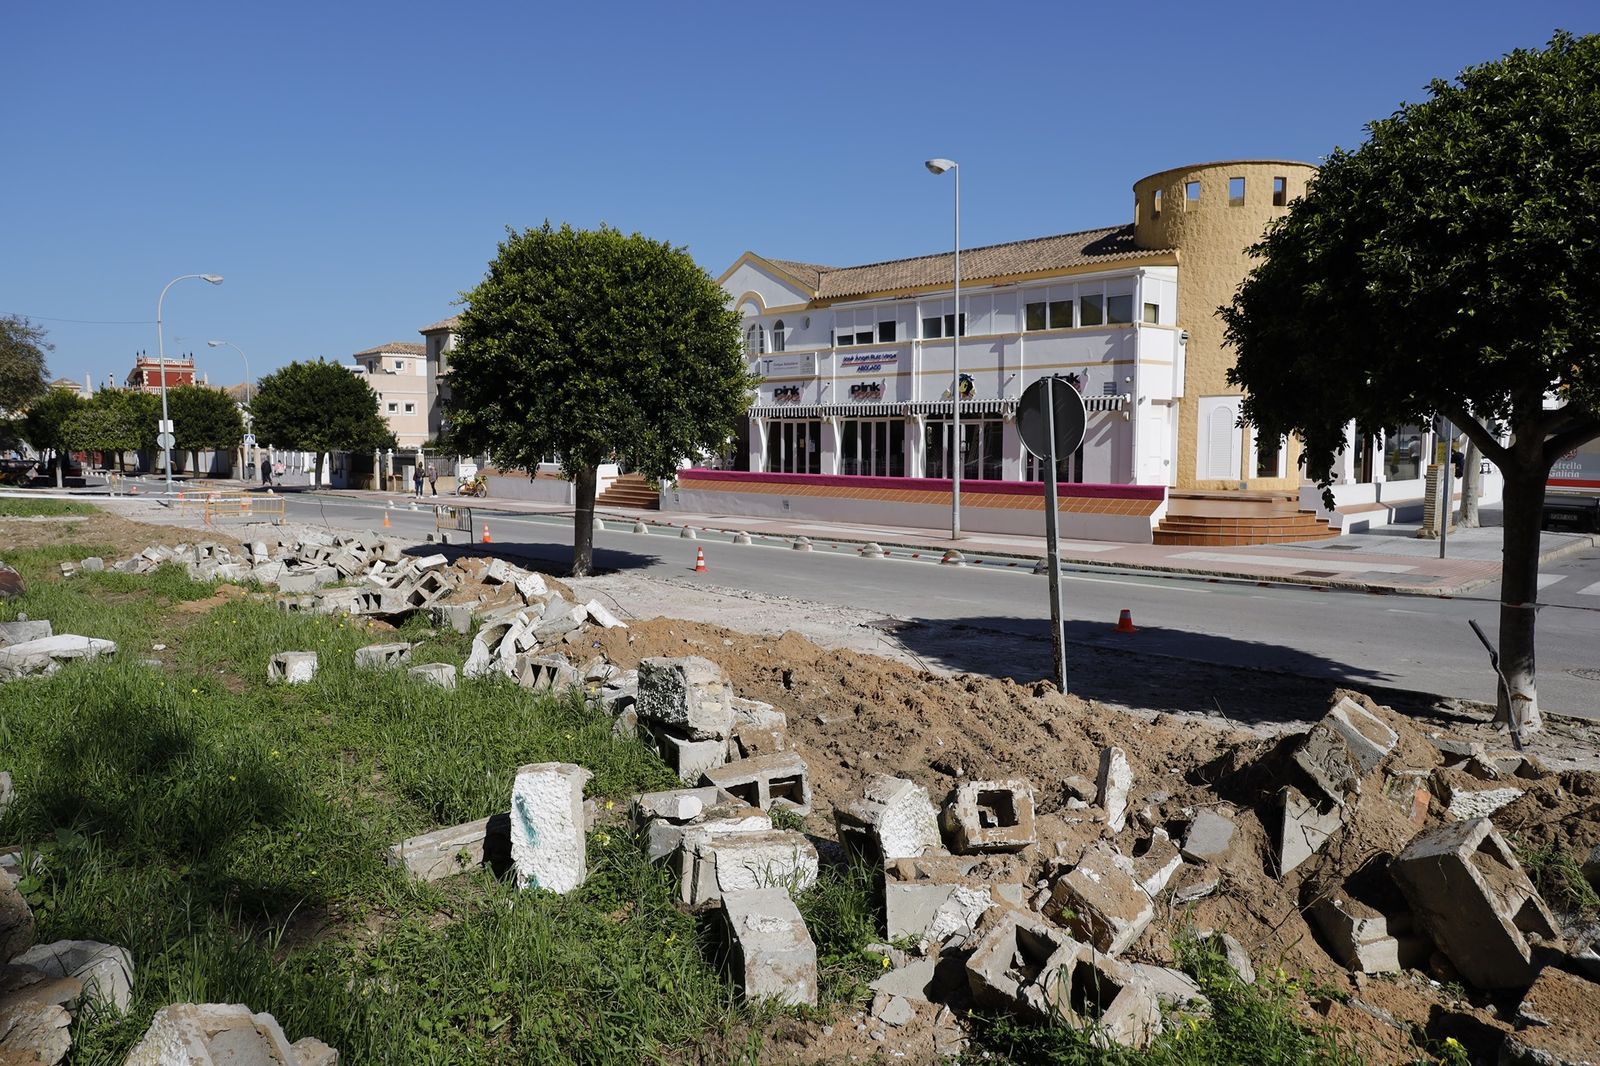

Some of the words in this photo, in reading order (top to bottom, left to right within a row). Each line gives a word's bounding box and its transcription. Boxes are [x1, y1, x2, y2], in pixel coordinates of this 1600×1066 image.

[774, 385, 799, 397] pink
[851, 381, 880, 394] pink
[1553, 462, 1582, 470] strella
[1549, 470, 1580, 478] Galicia
